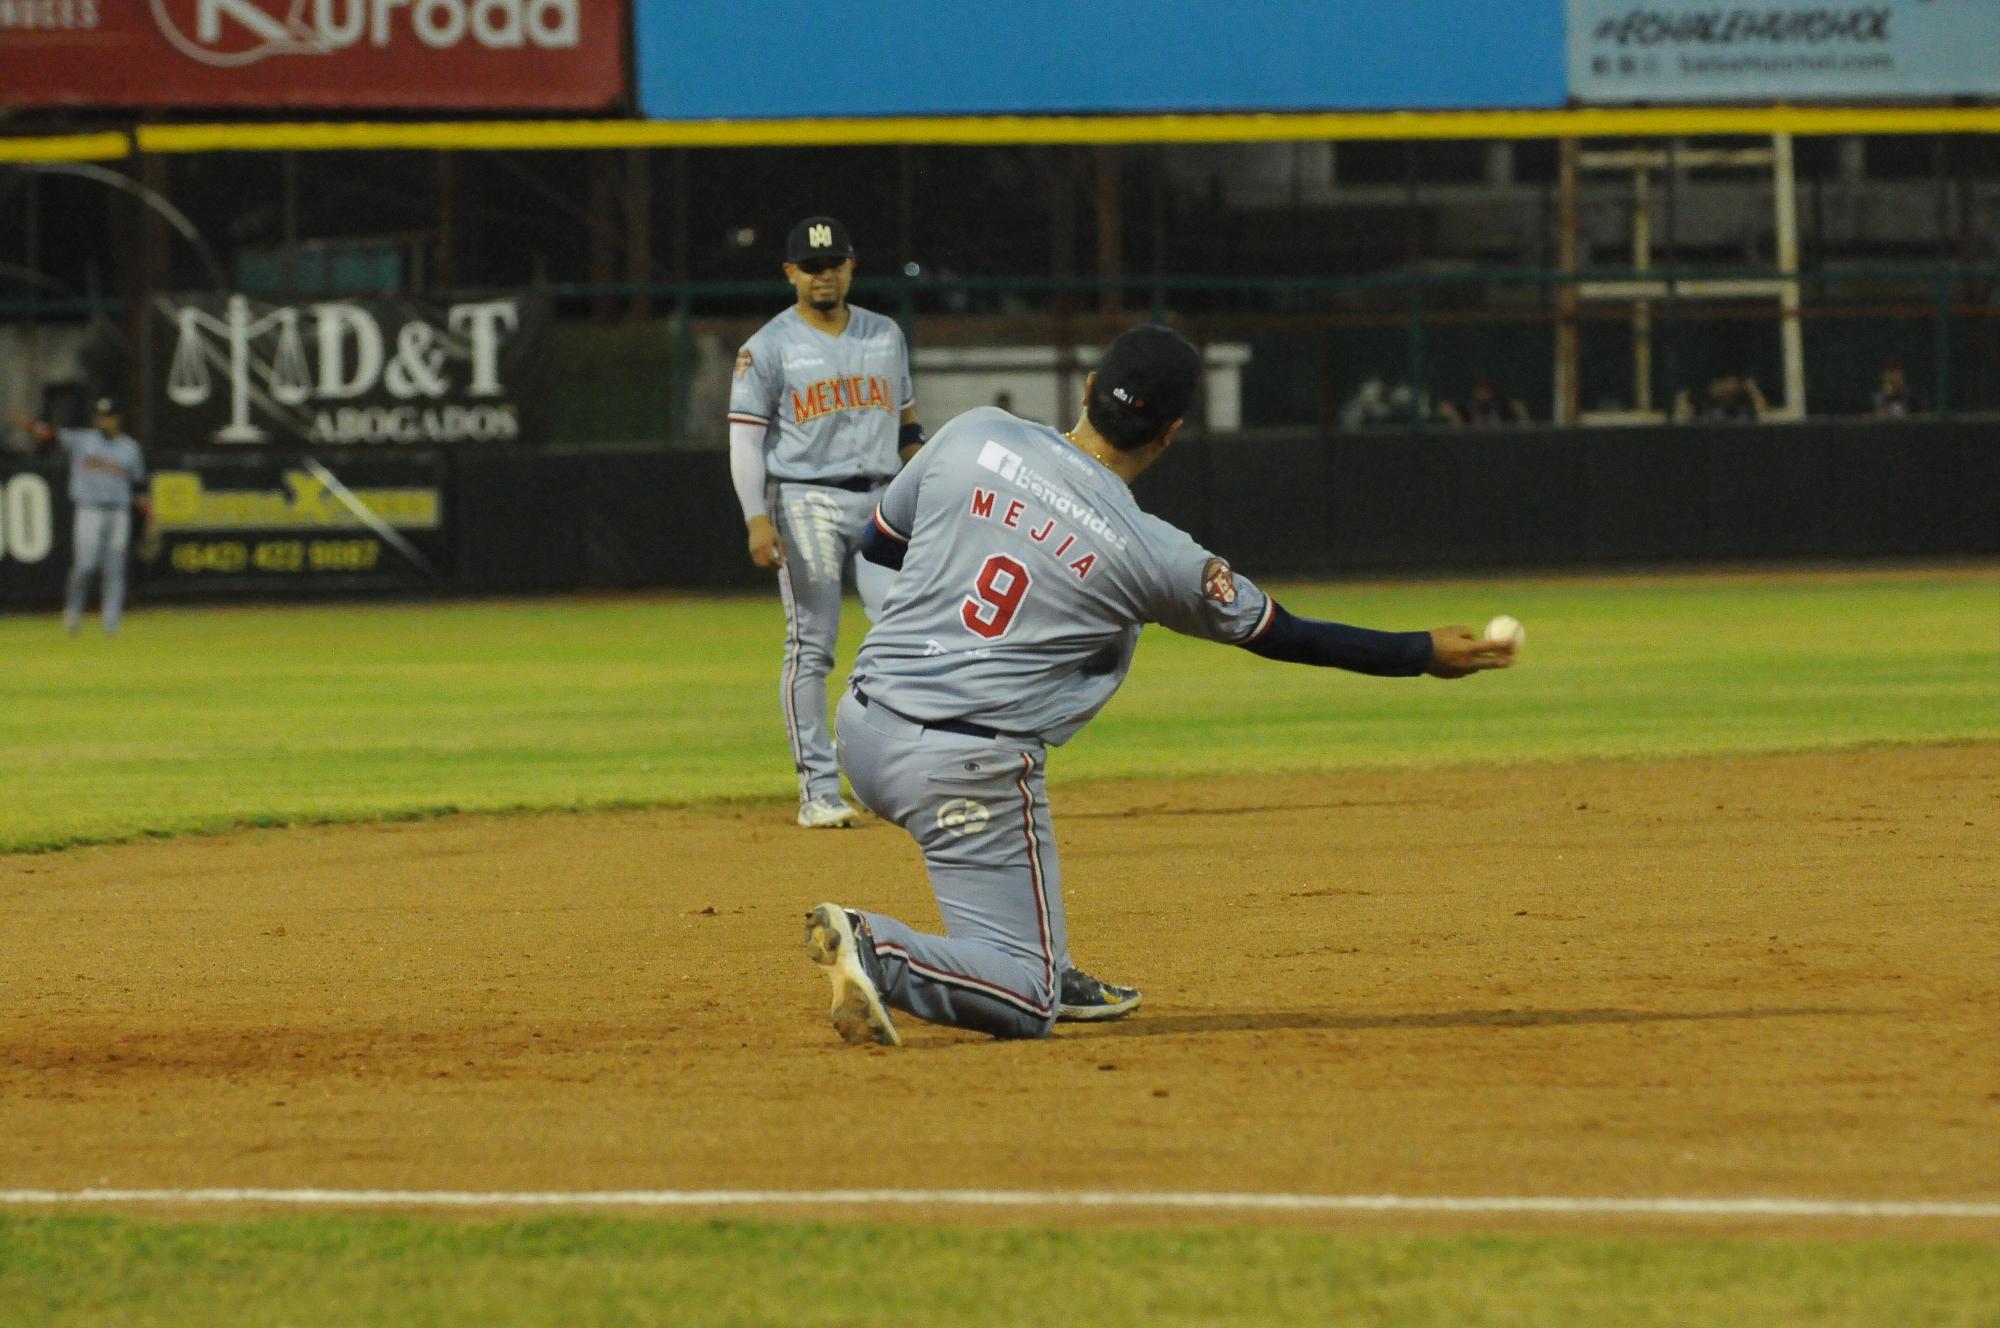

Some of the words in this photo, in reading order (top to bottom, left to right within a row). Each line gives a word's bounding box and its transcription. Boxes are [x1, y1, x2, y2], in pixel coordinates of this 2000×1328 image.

[312, 301, 518, 398] D&T
[313, 406, 518, 442] ABOGADOS
[791, 372, 896, 425] MEXICAL
[970, 487, 1098, 582] MEJIA
[1015, 466, 1128, 551] benavides
[960, 552, 1033, 639] 9
